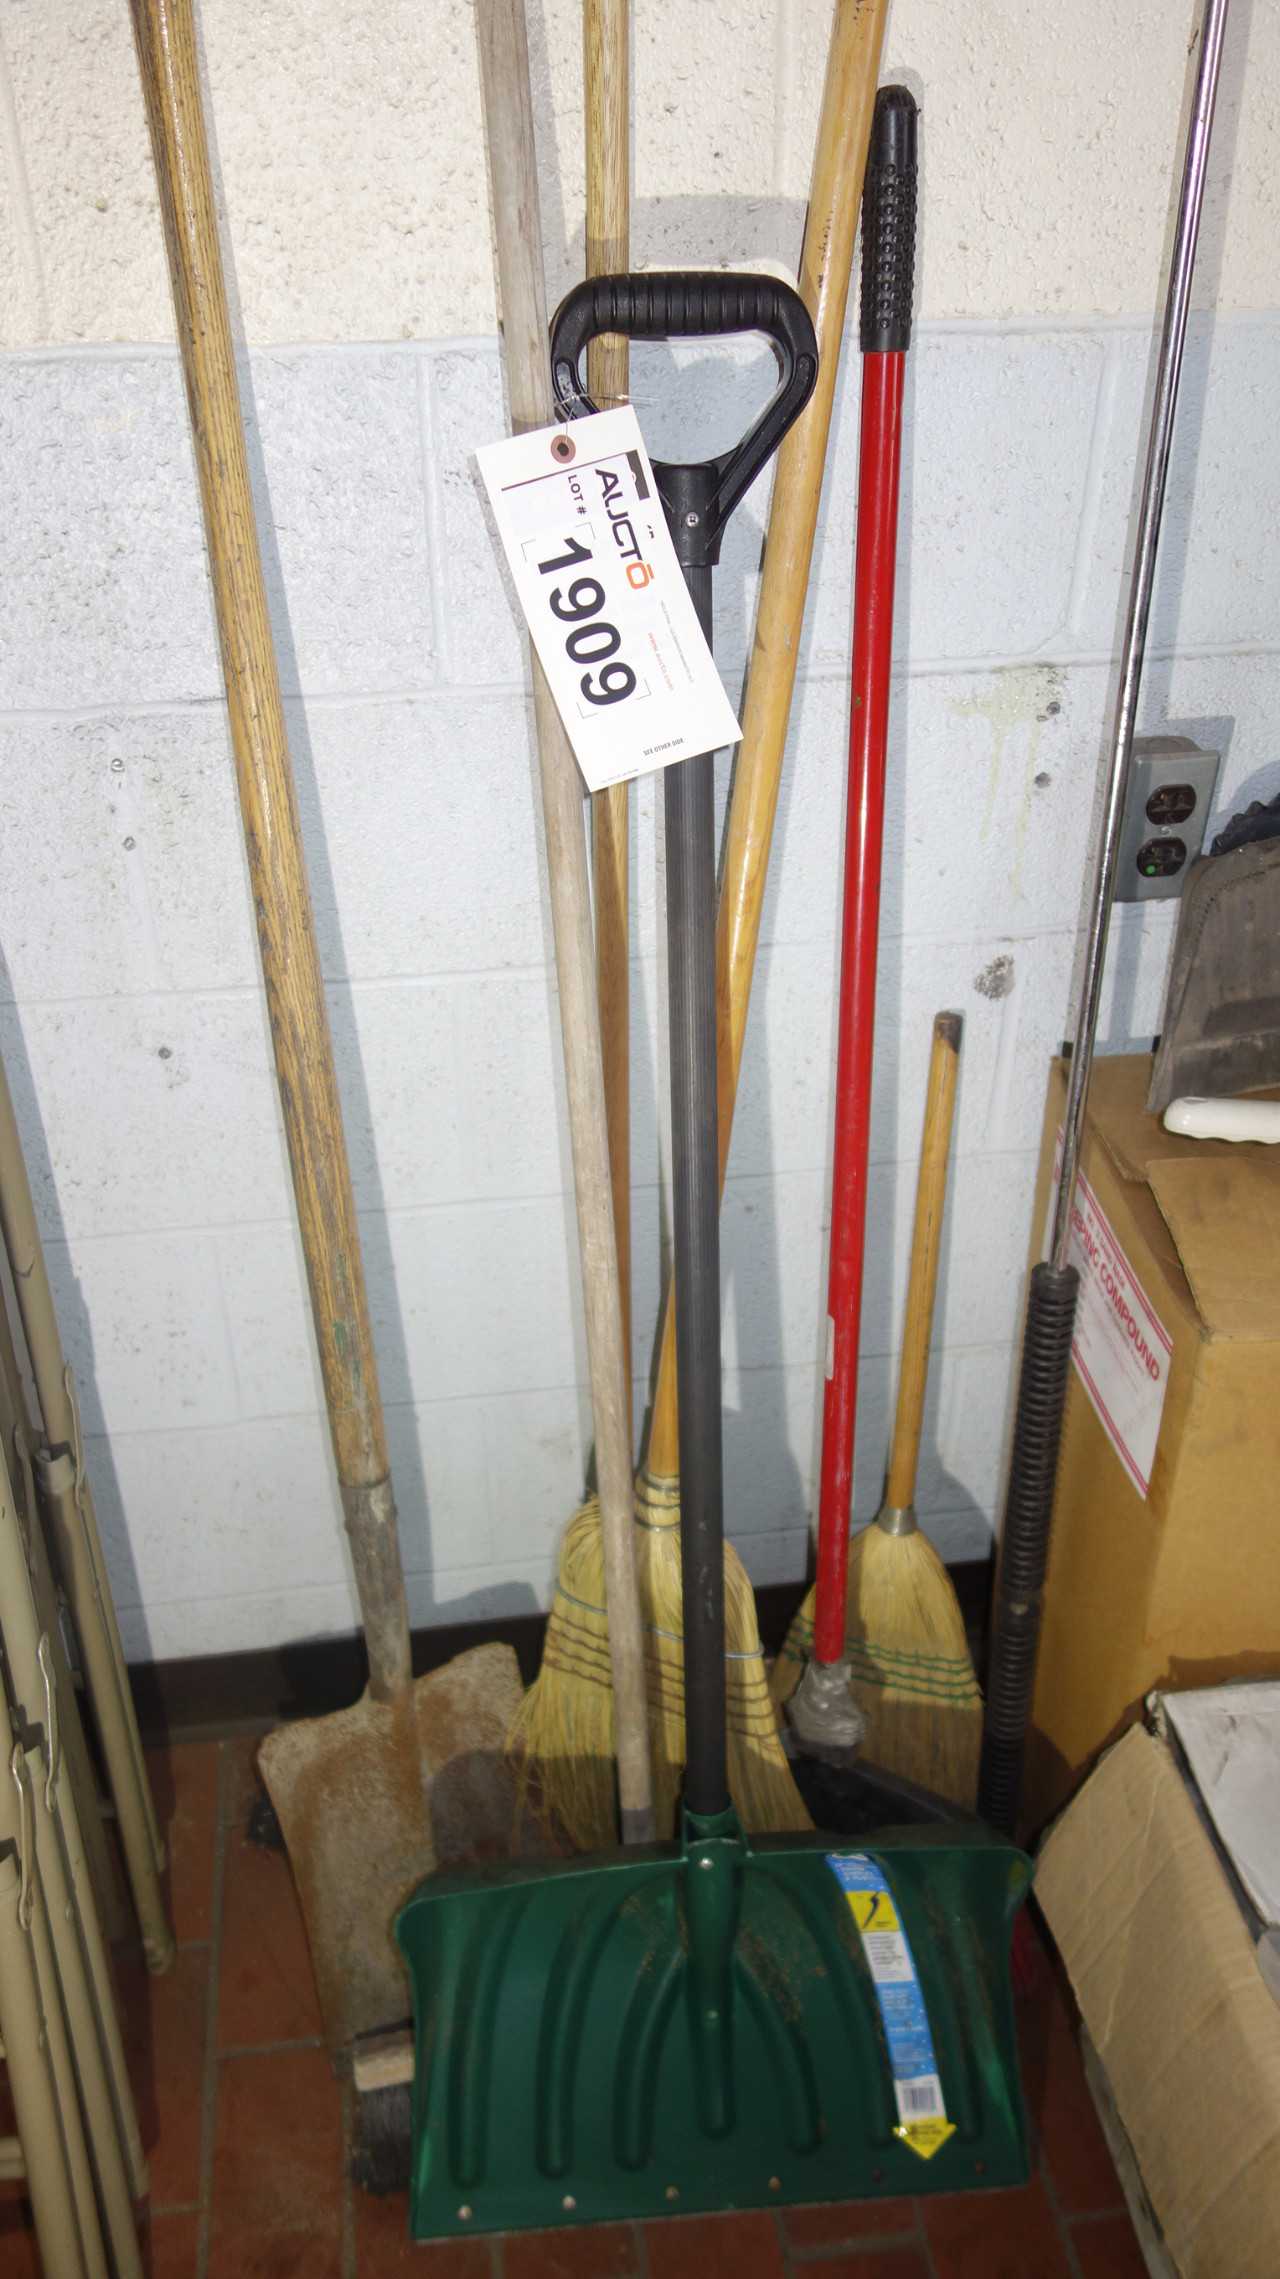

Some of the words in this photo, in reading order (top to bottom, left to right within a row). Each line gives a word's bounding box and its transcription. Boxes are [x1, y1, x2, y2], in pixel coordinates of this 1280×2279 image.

[567, 474, 584, 502] LOT
[576, 505, 587, 515] #
[538, 536, 637, 706] 1909
[1100, 1262, 1160, 1381] COMPOUND
